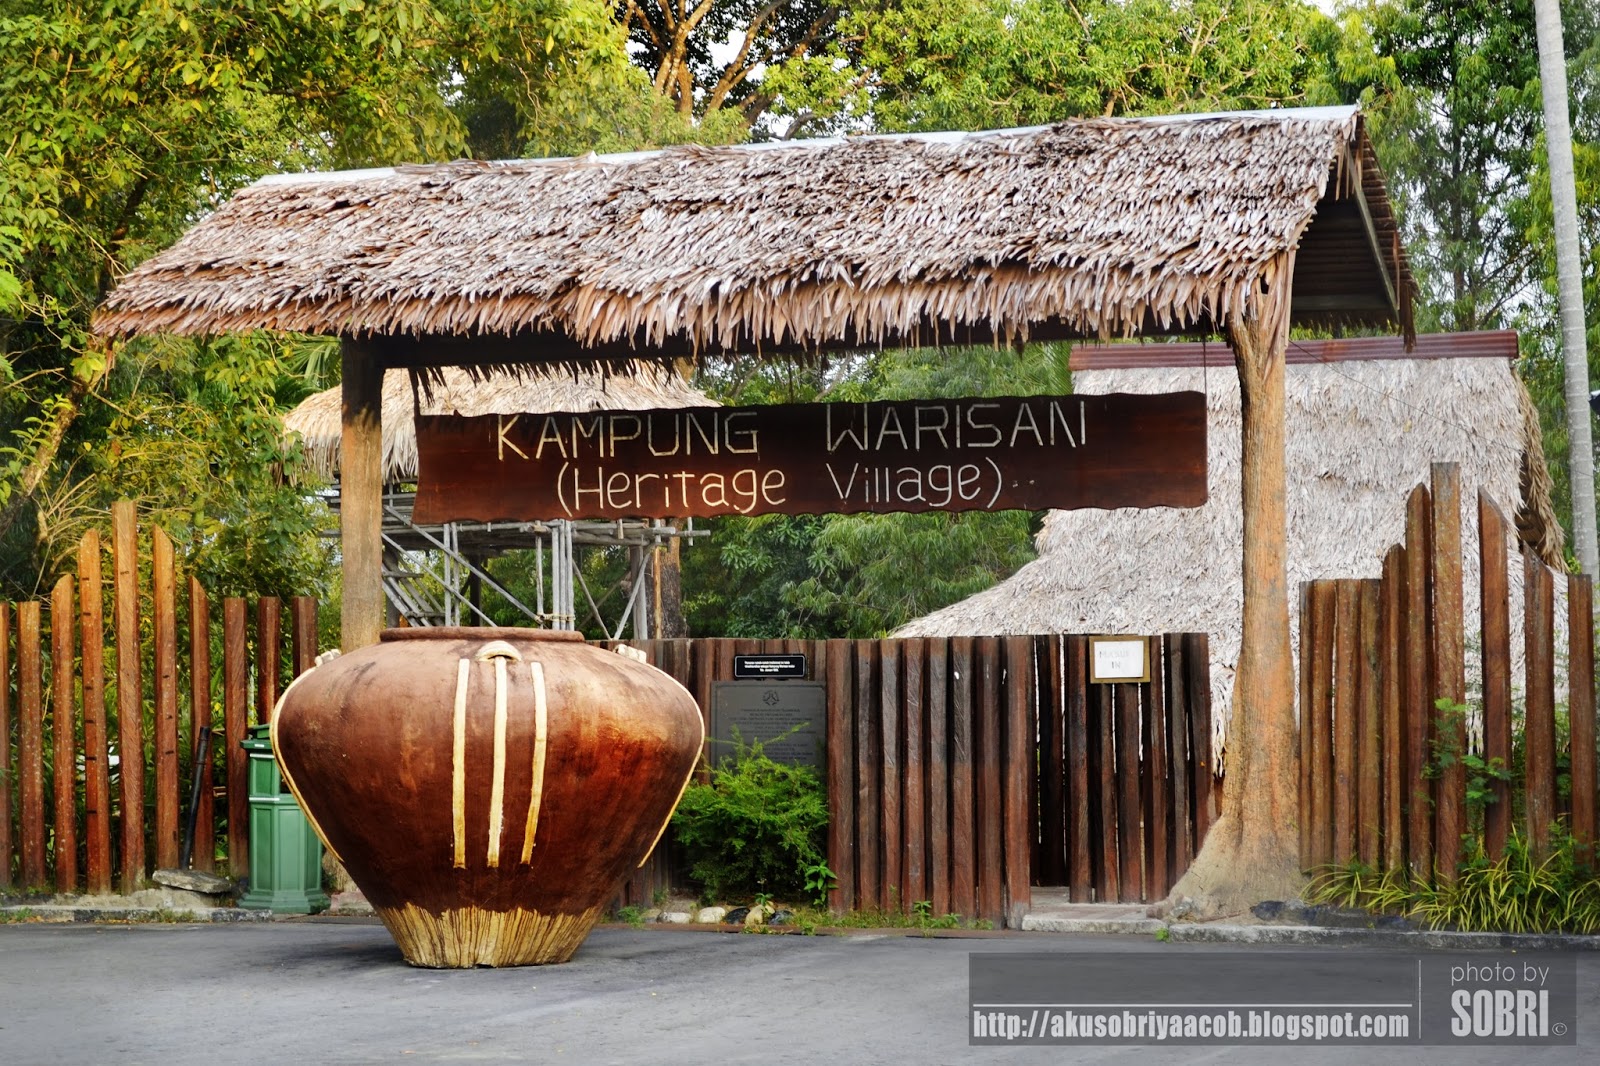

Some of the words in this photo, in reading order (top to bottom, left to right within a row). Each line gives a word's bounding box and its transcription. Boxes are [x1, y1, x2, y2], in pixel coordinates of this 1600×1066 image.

[498, 411, 759, 460] KAMPUNG
[826, 400, 1087, 452] WARISAN
[558, 461, 786, 517] (Heritage
[826, 457, 1002, 508] Village)
